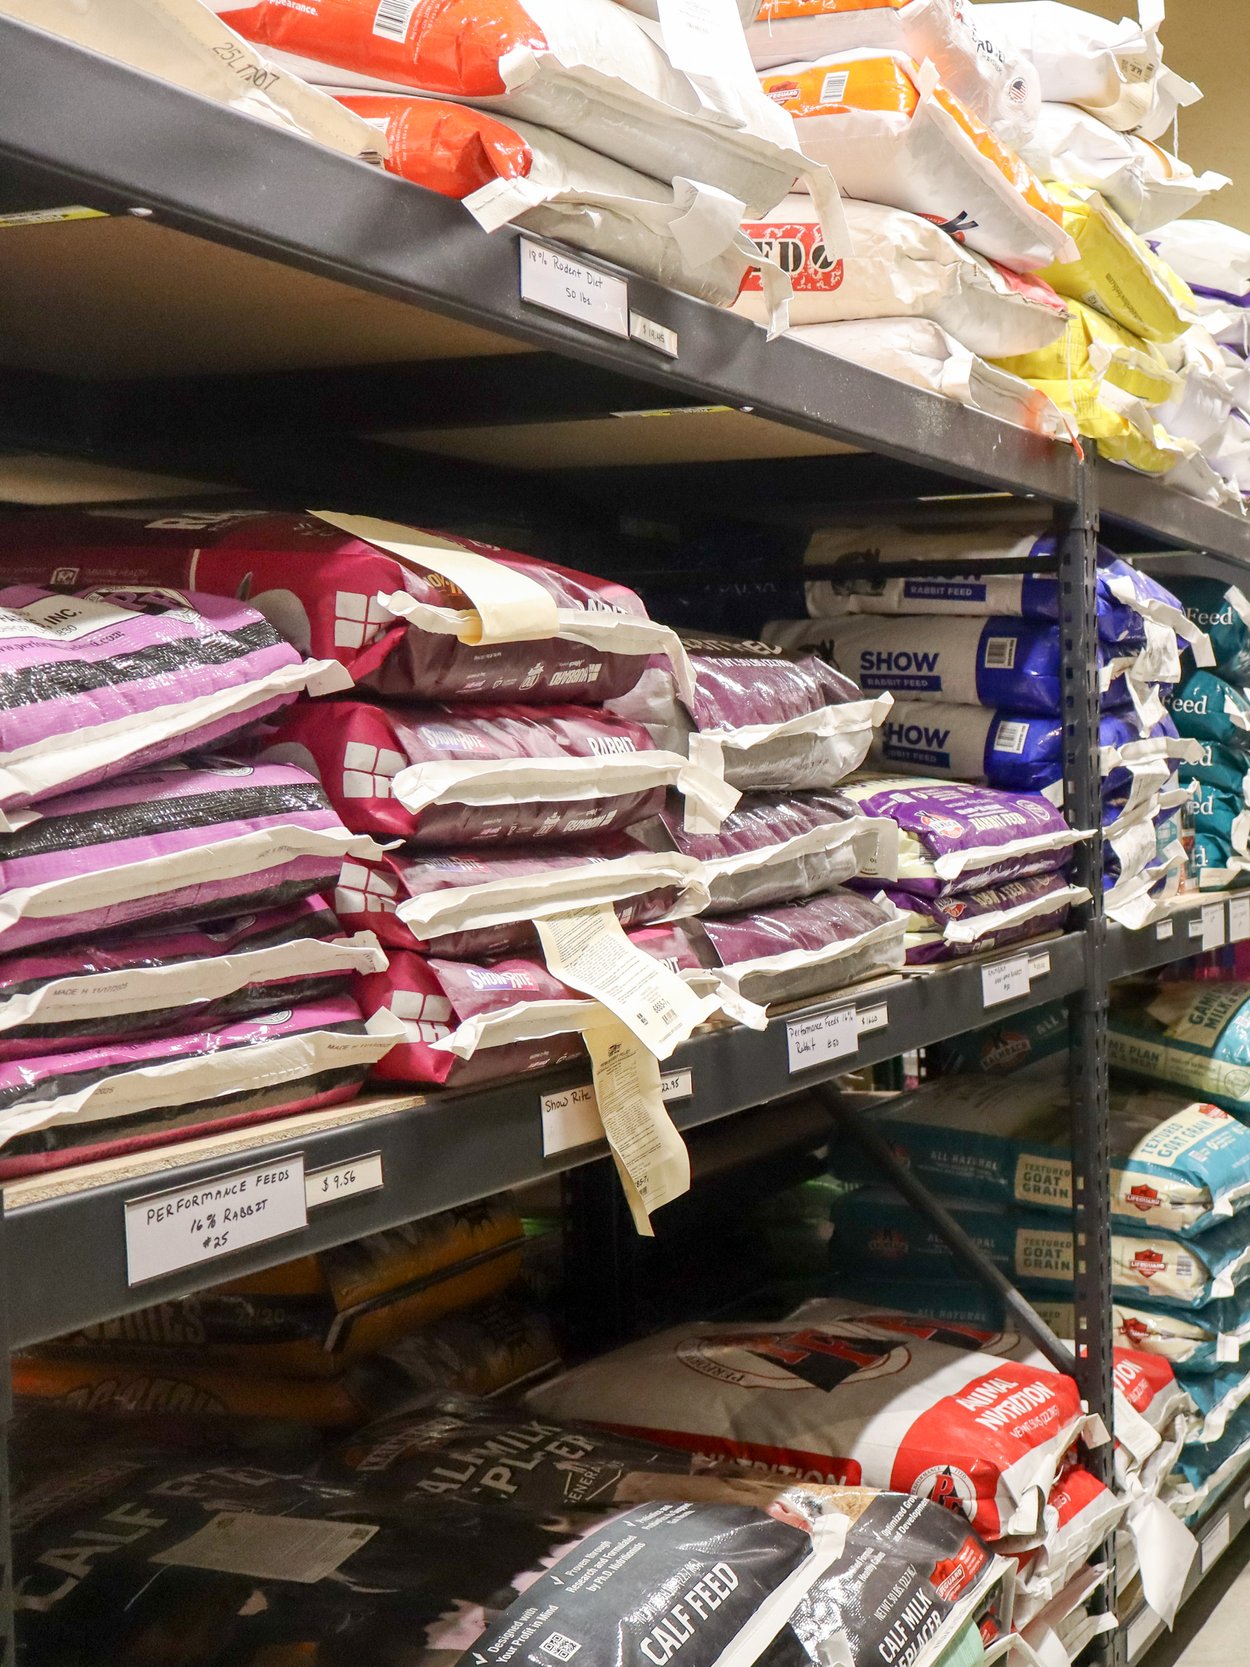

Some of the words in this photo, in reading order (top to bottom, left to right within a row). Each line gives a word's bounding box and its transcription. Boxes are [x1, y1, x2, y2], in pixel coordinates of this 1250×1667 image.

[552, 255, 582, 278] Rodent
[586, 272, 603, 289] Diet
[565, 287, 576, 299] 50
[910, 585, 944, 596] RABBIT
[948, 587, 972, 596] FEED
[1185, 607, 1233, 625] Feed
[859, 651, 939, 673] SHOW
[868, 678, 901, 687] RABBIT
[904, 679, 928, 687] FEED
[1162, 694, 1207, 714] Feed
[587, 736, 636, 755] RABBIT
[883, 722, 950, 749] HOW
[465, 969, 533, 989] SHOW-RITE
[54, 987, 78, 996] MADE
[545, 1097, 568, 1113] Show
[571, 1090, 592, 1105] Rite
[1141, 1122, 1184, 1155] TEXTURED
[1156, 1130, 1190, 1158] GOAT
[1185, 1119, 1215, 1146] GRAIN
[930, 1151, 948, 1162] ALL
[951, 1153, 998, 1170] NATURAL
[1024, 1163, 1071, 1176] TEXTURED
[1023, 1173, 1061, 1187] GOAT
[146, 1182, 247, 1225] PERFORMANCE
[255, 1169, 290, 1187] FEEDS
[1022, 1183, 1069, 1199] GRAIN
[1126, 1195, 1162, 1206] LIFEGUARD
[190, 1214, 216, 1234] 16%
[223, 1199, 268, 1223] RABBIT
[203, 1231, 229, 1249] #25
[1024, 1238, 1072, 1249] TEXTURED
[1023, 1247, 1063, 1259] GOAT
[1023, 1259, 1070, 1271] GRAIN
[940, 1310, 987, 1321] NATURAL
[956, 1377, 1019, 1412] ANIMAL
[975, 1381, 1056, 1431] NUTRITION
[881, 1504, 907, 1539] Optimized
[564, 1557, 589, 1577] Proven
[565, 1566, 597, 1593] Research
[593, 1558, 607, 1571] and
[585, 1583, 597, 1593] by
[594, 1570, 616, 1589] Ph.D.
[880, 1599, 894, 1613] WT.
[887, 1592, 898, 1604] 50
[639, 1604, 695, 1666] CALF
[684, 1562, 739, 1621] FEED
[873, 1606, 888, 1621] NET
[487, 1618, 521, 1654] Designed
[520, 1606, 538, 1623] with
[496, 1642, 516, 1663] Your
[514, 1626, 536, 1649] Profit
[532, 1621, 542, 1631] in
[540, 1604, 560, 1625] Mind
[879, 1618, 908, 1664] CALF
[901, 1587, 933, 1633] MILK
